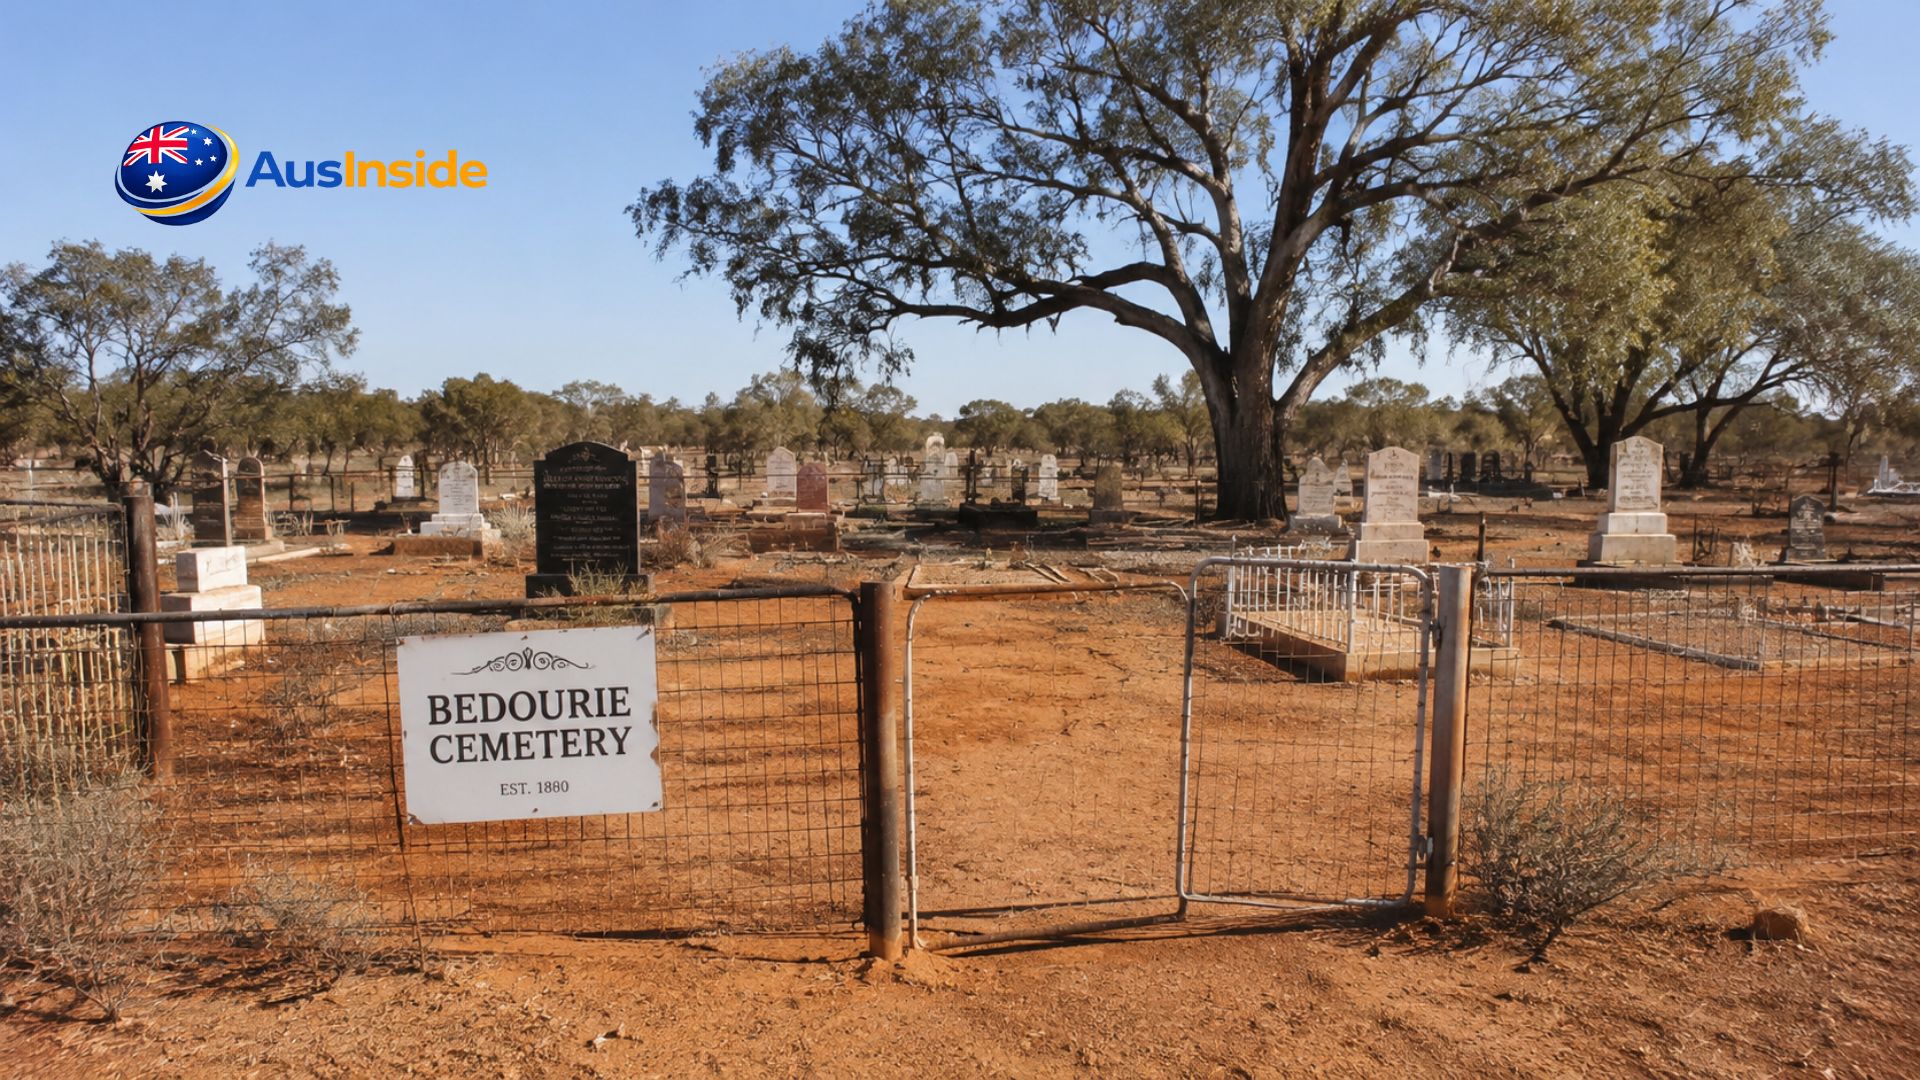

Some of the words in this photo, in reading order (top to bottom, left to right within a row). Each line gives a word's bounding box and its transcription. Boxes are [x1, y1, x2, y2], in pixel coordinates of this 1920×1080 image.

[427, 687, 631, 725] BEDOURIE
[430, 726, 632, 764] CEMETERY
[500, 782, 531, 796] EST.
[537, 780, 570, 795] 1880
